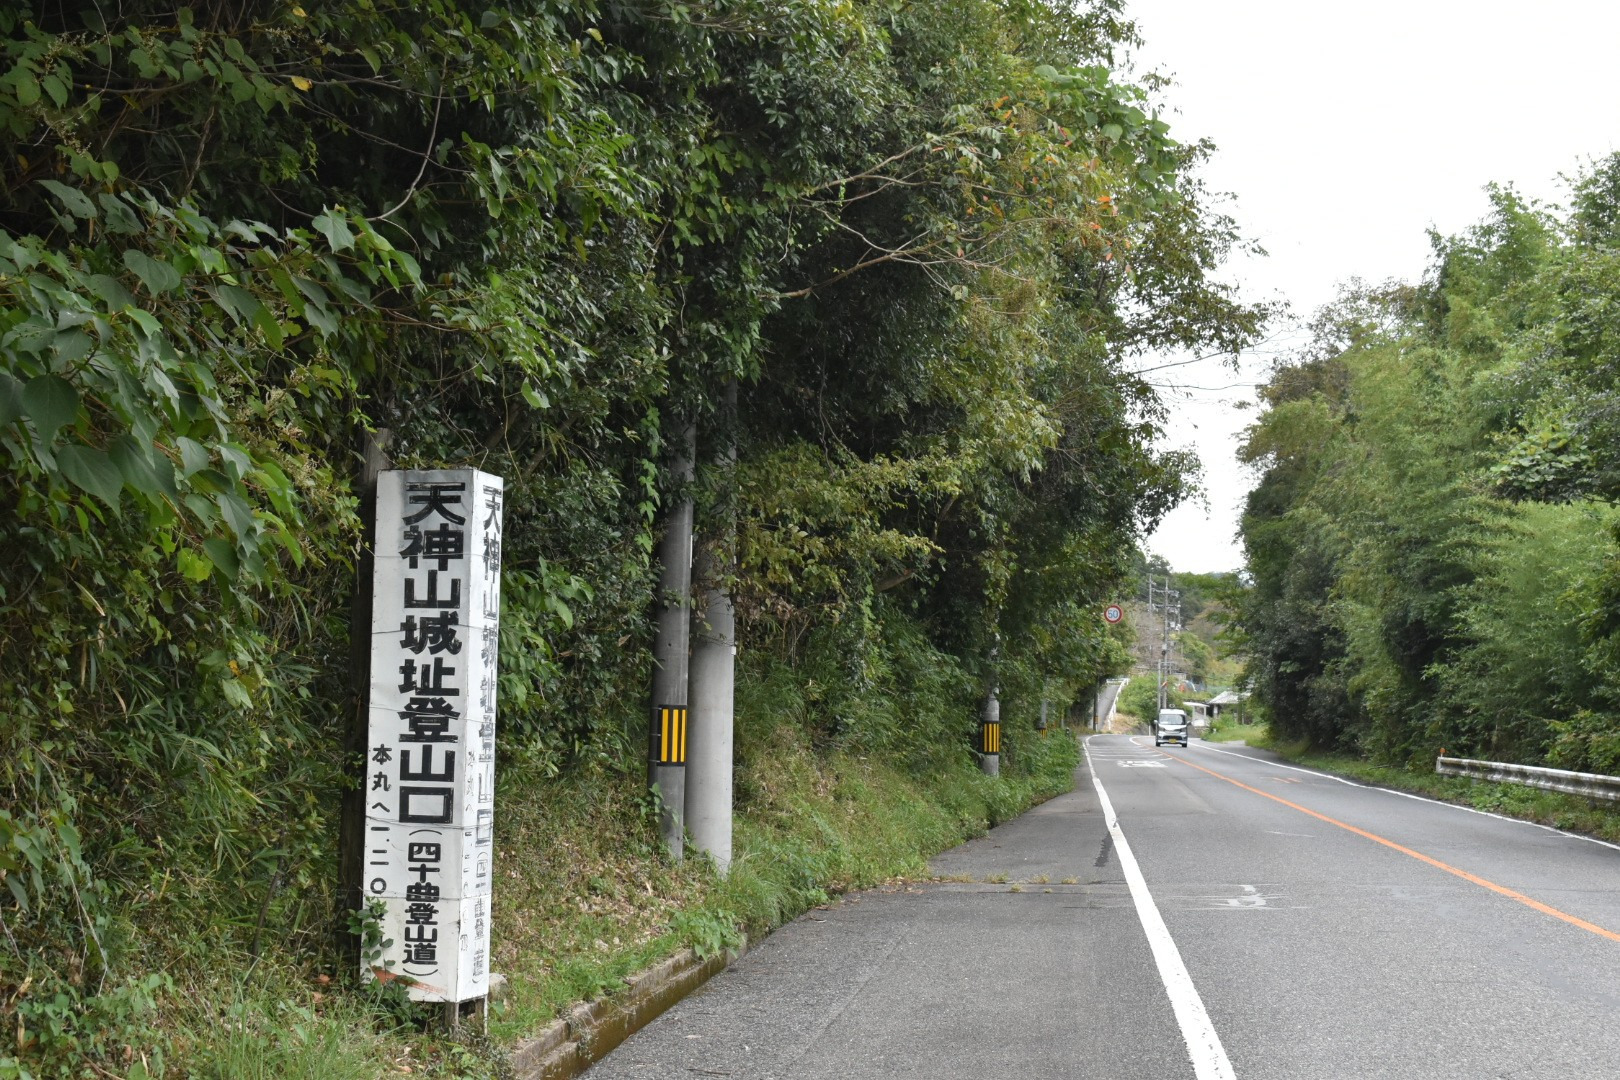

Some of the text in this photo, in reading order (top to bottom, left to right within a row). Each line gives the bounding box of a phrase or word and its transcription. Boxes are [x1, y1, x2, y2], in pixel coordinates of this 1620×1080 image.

[397, 482, 465, 824] 天神山城址登山口
[1107, 609, 1119, 619] 50
[402, 829, 443, 977] （四十曲登山道）
